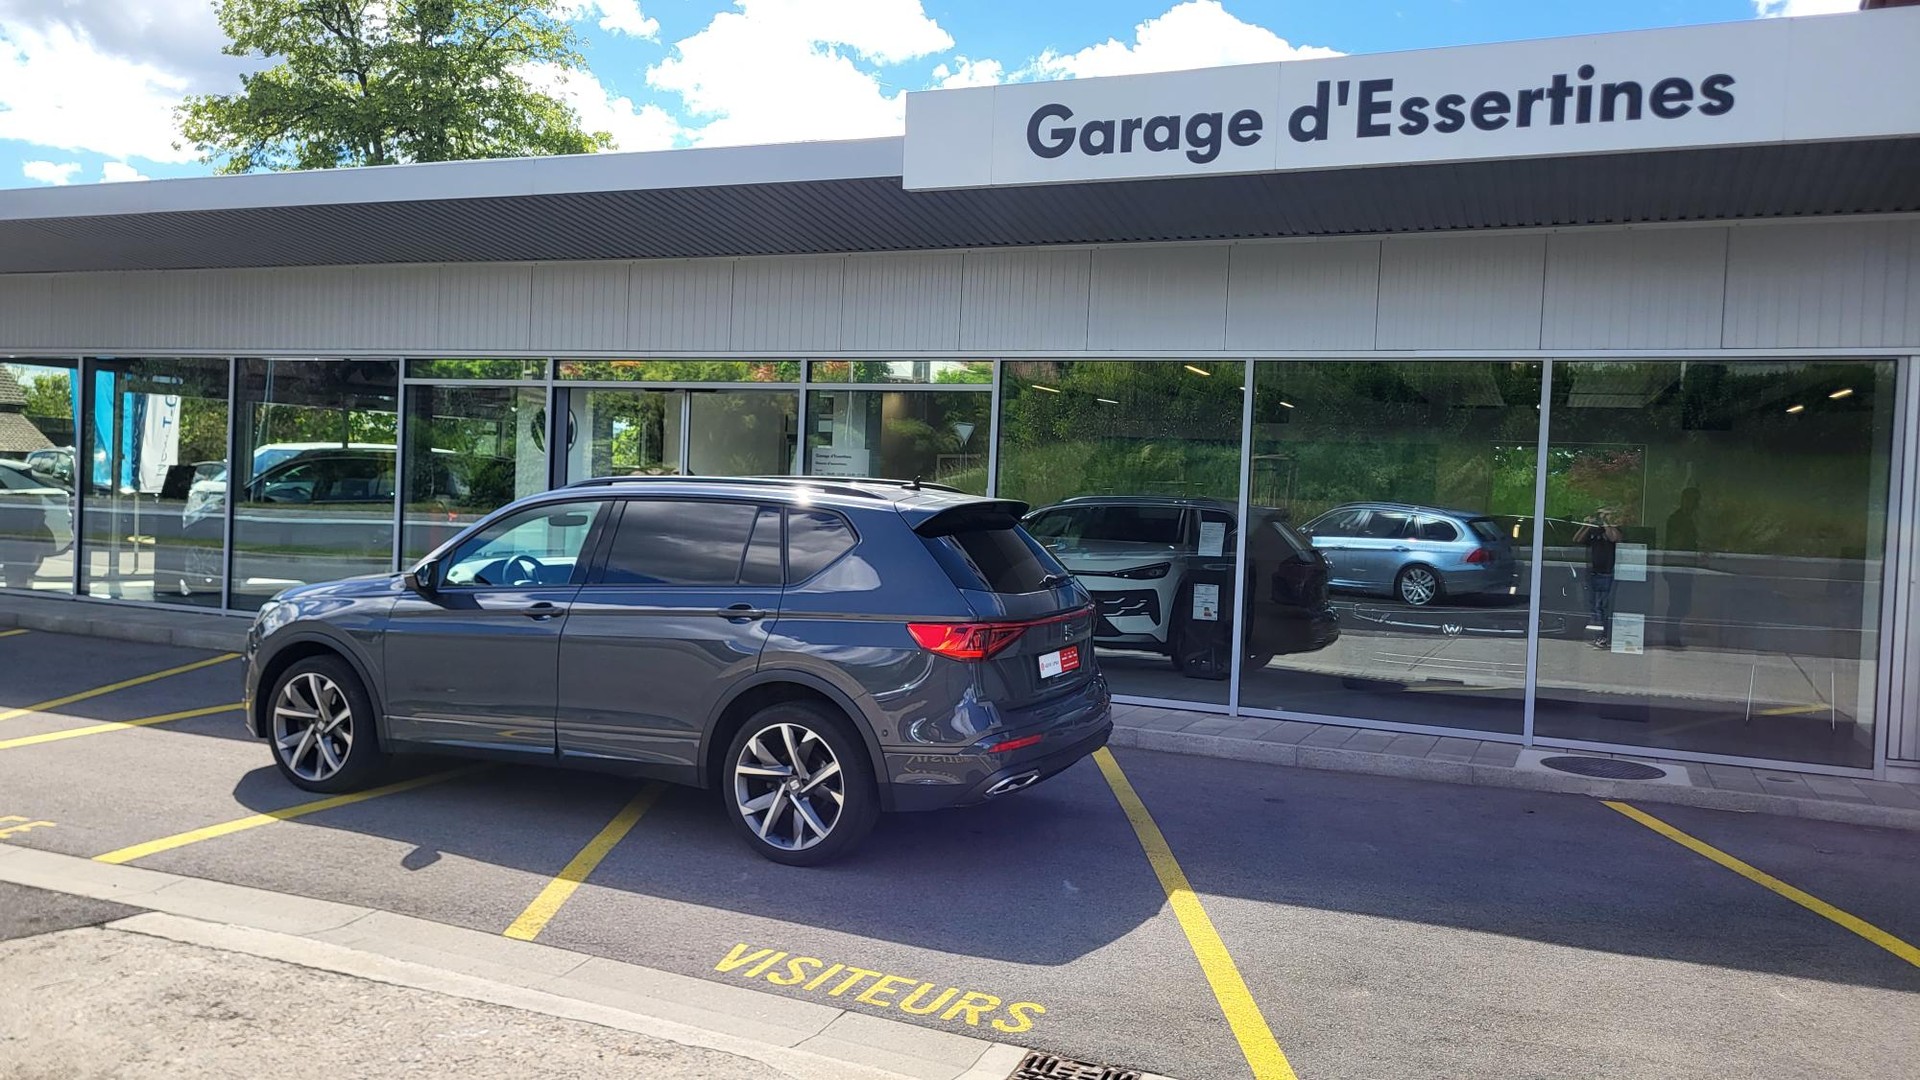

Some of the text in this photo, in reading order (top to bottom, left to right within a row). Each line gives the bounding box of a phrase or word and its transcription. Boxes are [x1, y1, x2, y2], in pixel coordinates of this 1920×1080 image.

[1026, 64, 1736, 165] Garage d'Essertines
[713, 942, 1047, 1034] VISITEURS
